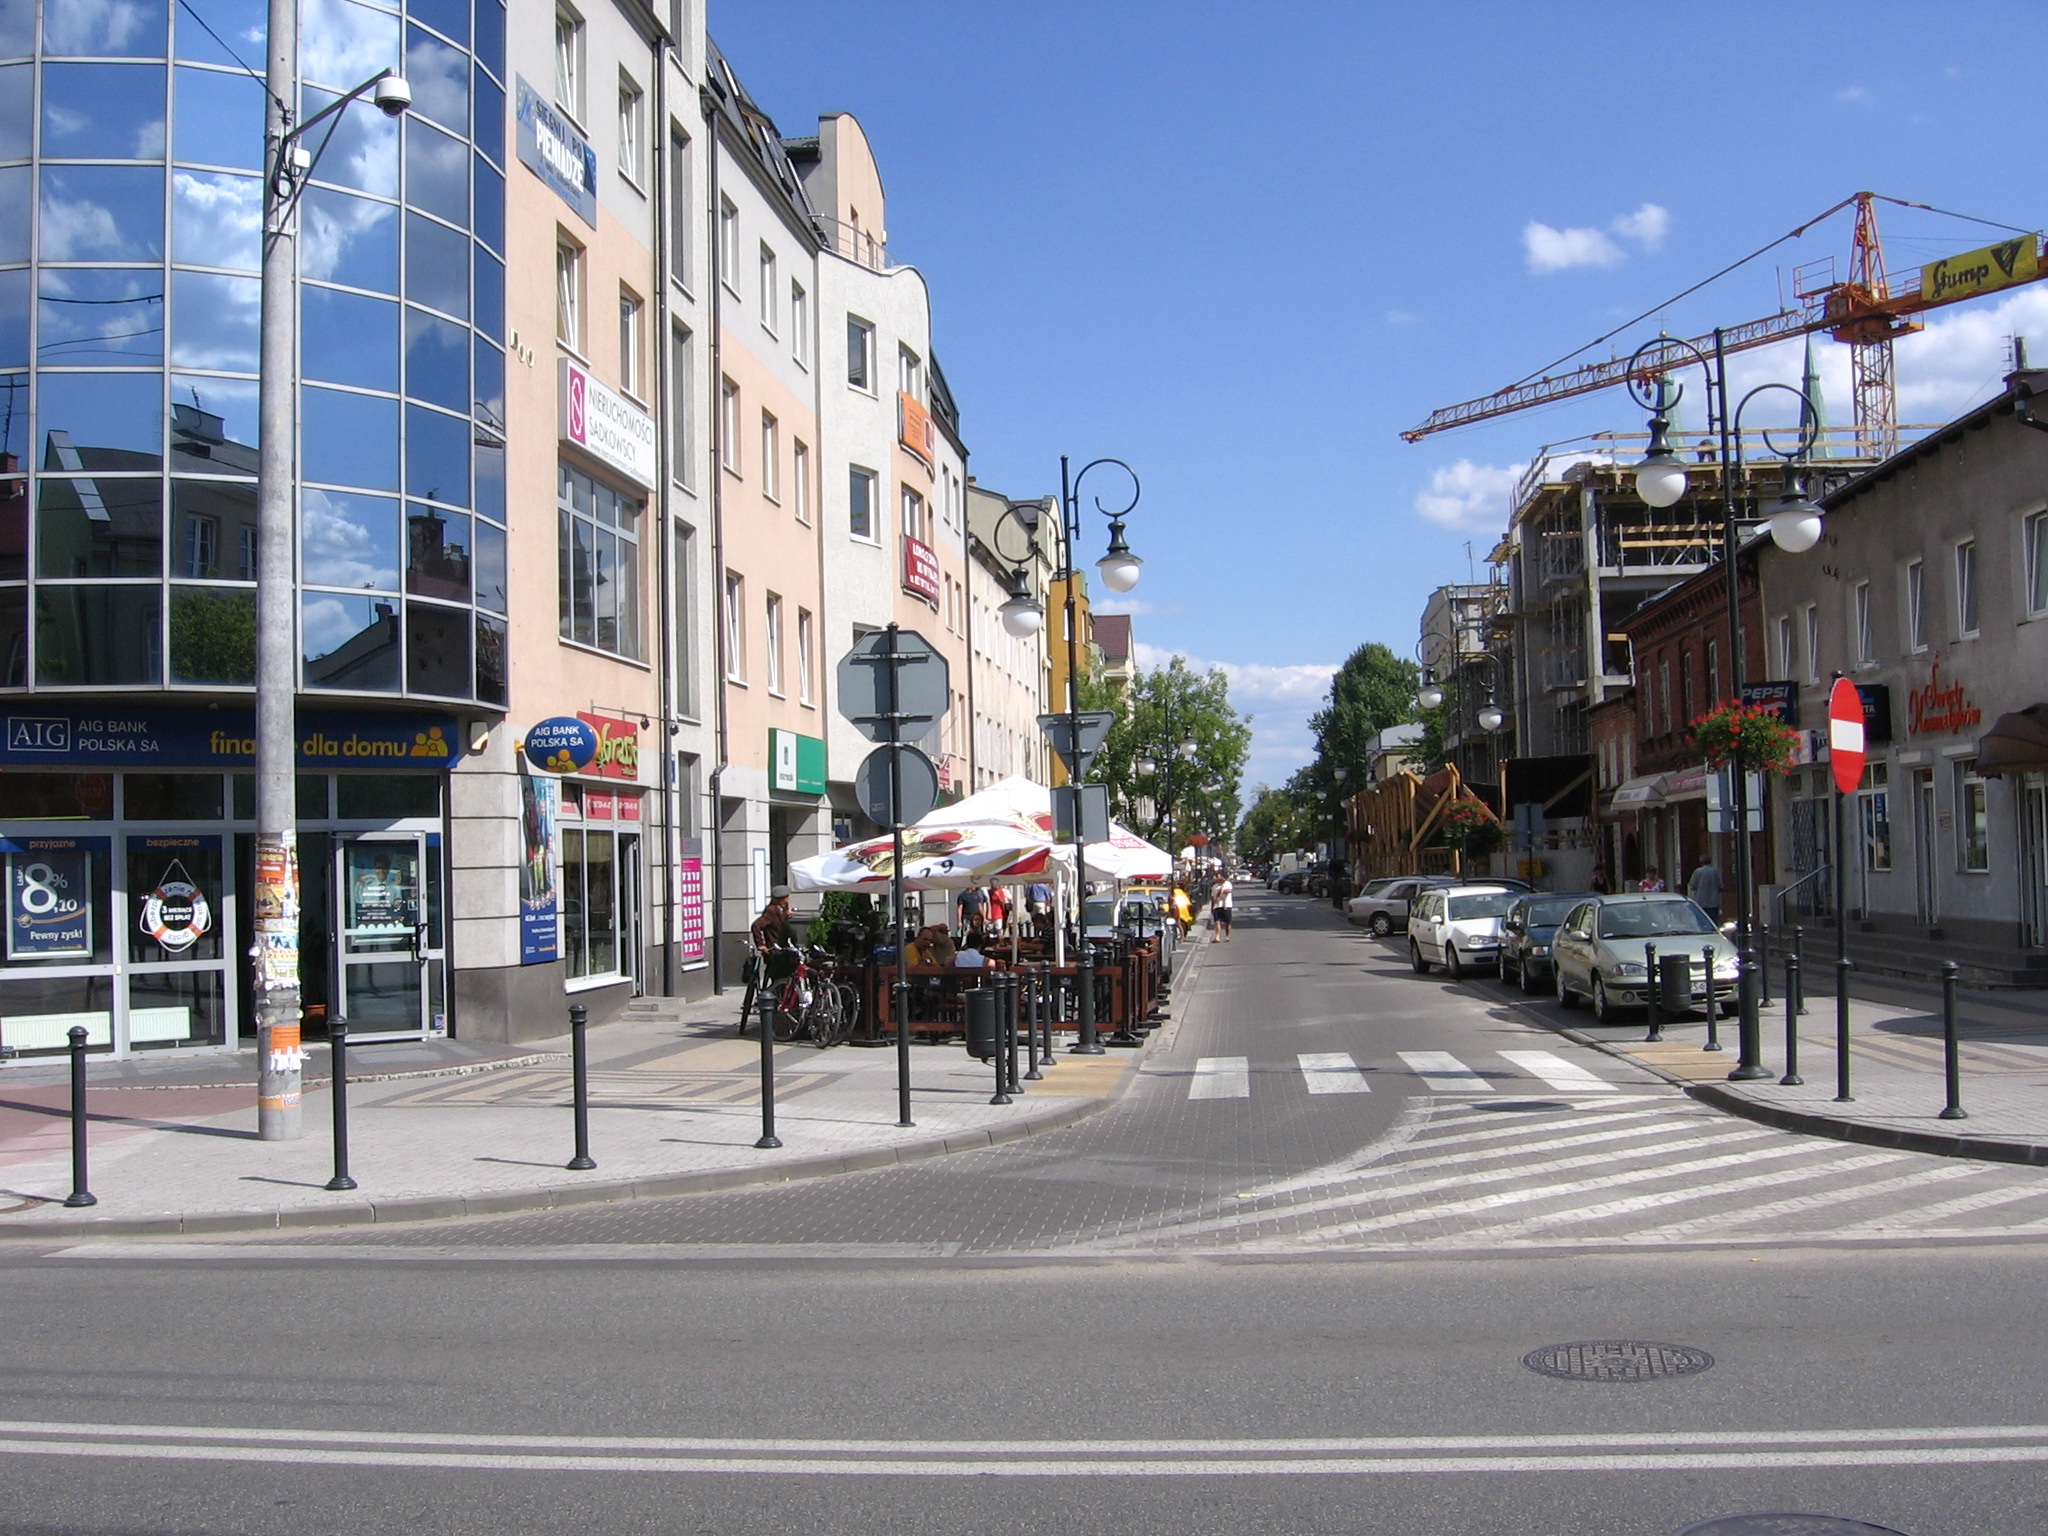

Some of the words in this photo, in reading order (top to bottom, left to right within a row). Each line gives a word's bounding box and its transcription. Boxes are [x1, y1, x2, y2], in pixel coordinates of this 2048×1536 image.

[588, 384, 652, 446] NIERUCHOMOŚCI
[588, 415, 637, 462] SADKOWSCY
[1741, 686, 1790, 699] PEPSI
[78, 720, 103, 732] AIG
[107, 721, 148, 733] BANK
[534, 727, 550, 736] AIG
[552, 725, 580, 735] BANK
[13, 722, 66, 746] AIG
[78, 738, 137, 751] POLSKA
[140, 740, 160, 752] SA
[303, 733, 338, 756] dla
[343, 734, 408, 757] domu
[531, 739, 567, 748] POLSKA
[569, 736, 584, 746] SA
[29, 839, 76, 850] przyjazne
[146, 837, 200, 848] bezpieczne
[30, 931, 59, 941] Pewny
[61, 929, 83, 941] zysk!
